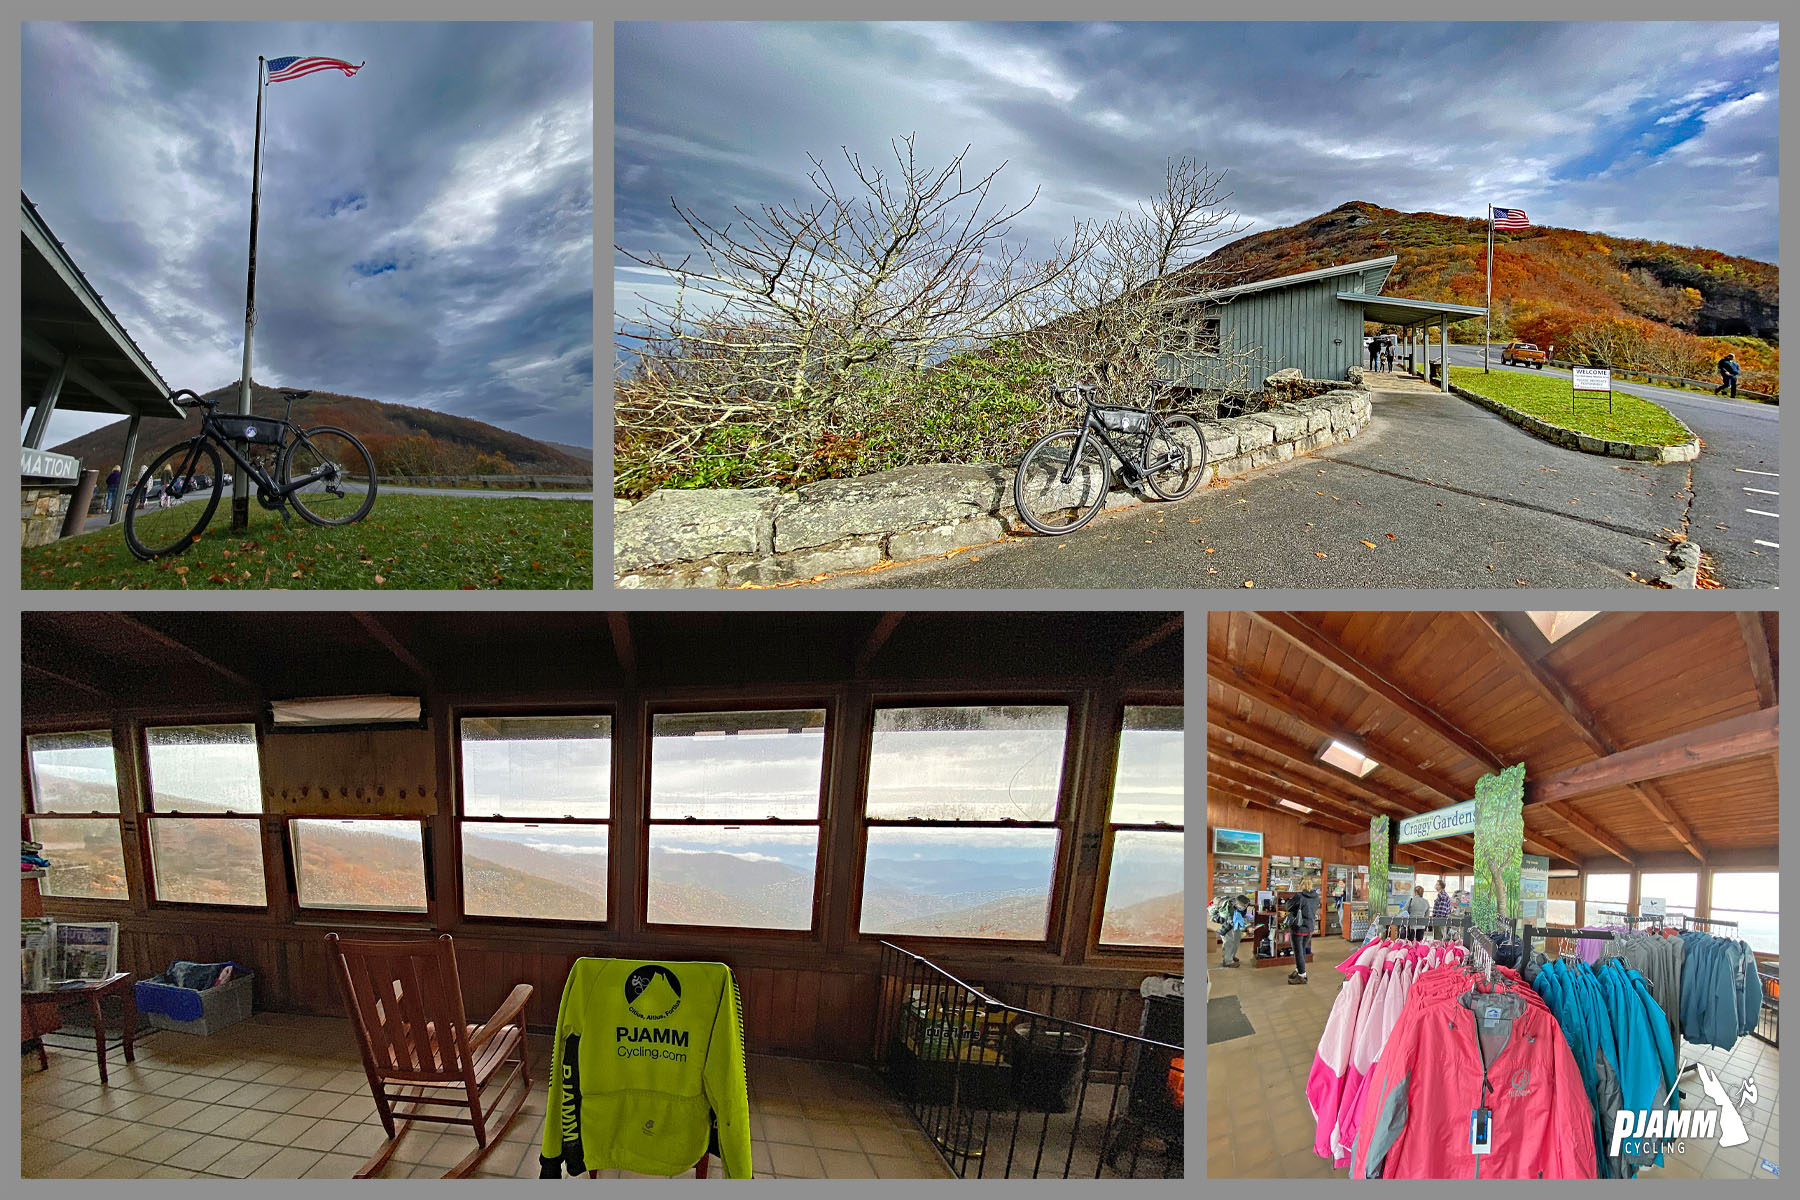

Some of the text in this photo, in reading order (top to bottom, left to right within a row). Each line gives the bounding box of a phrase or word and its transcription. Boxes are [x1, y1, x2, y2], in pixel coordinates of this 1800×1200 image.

[1403, 821, 1432, 837] Craggy
[616, 1026, 689, 1048] PJAMM
[617, 1045, 687, 1063] Cycling.com
[562, 1064, 579, 1142] PJAMM
